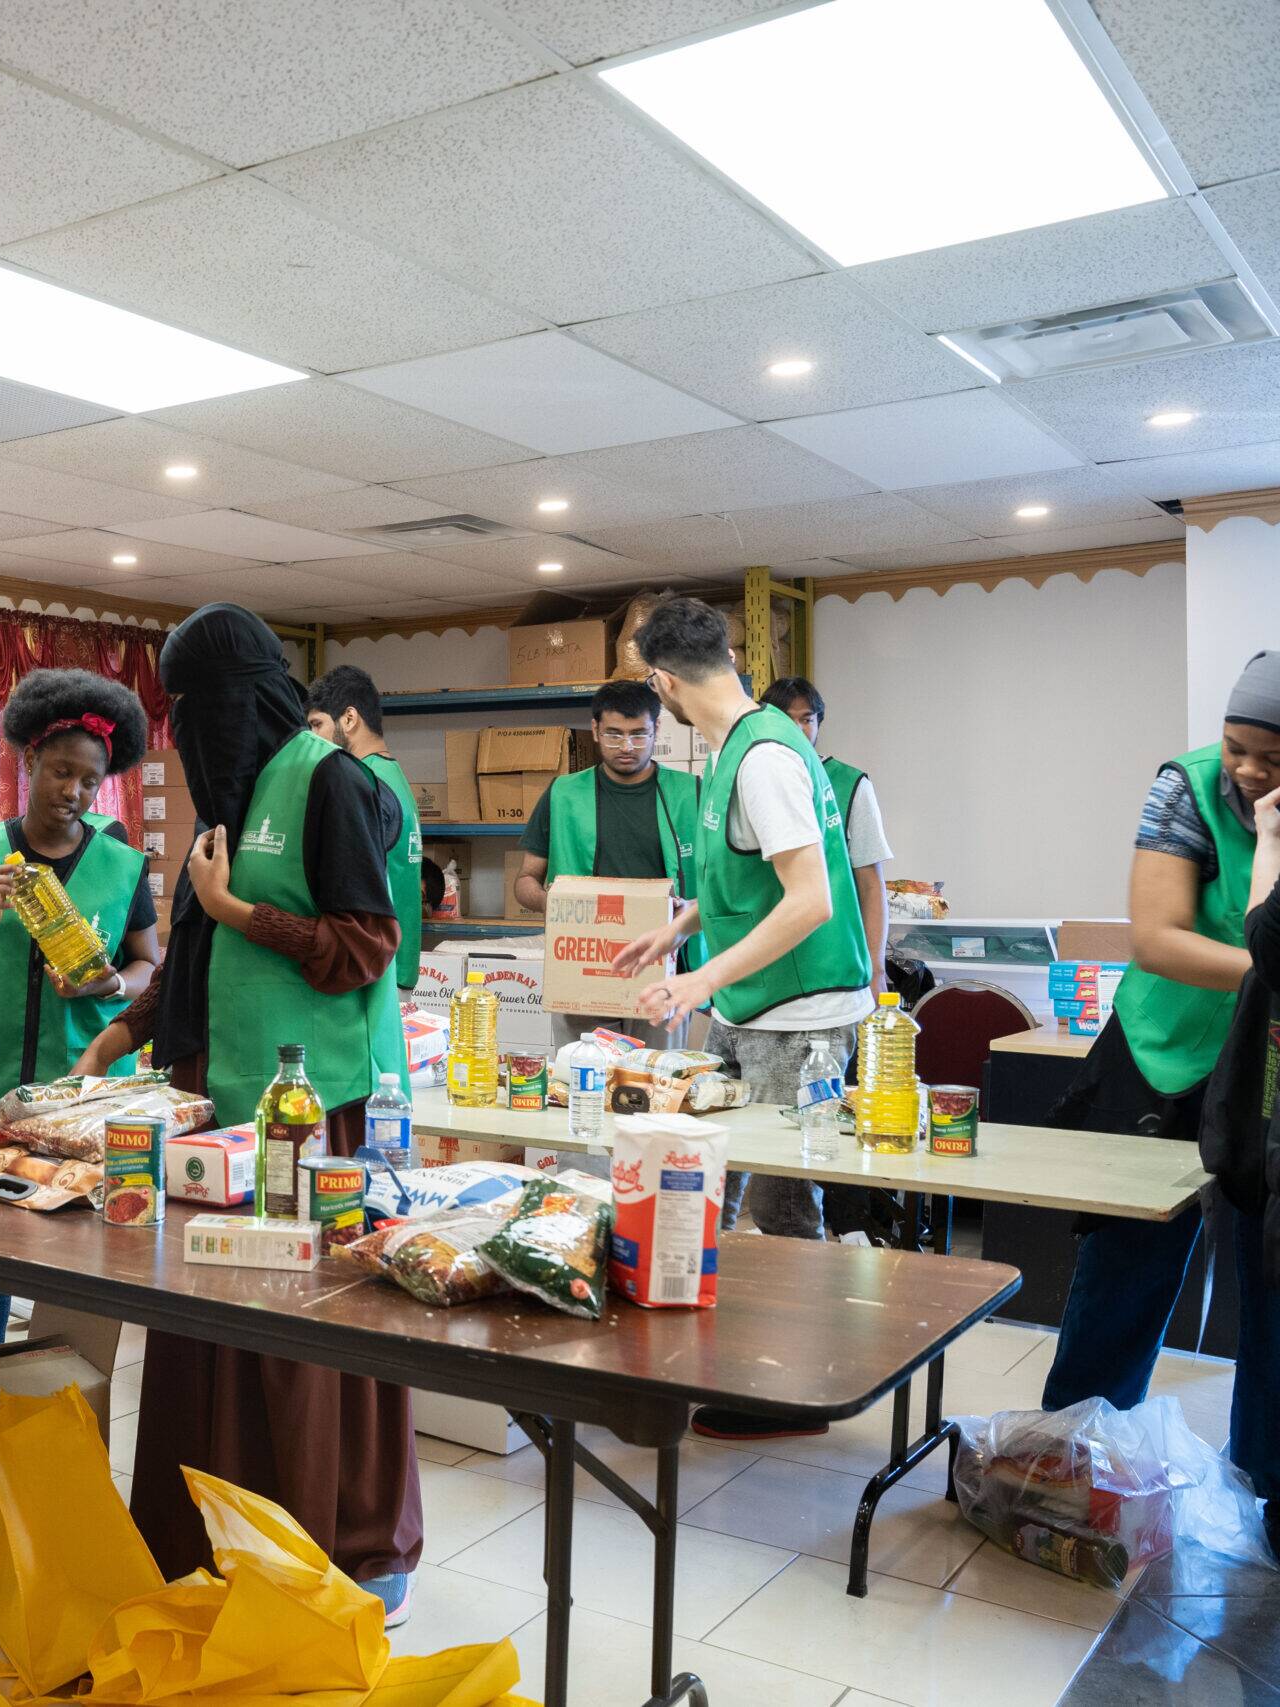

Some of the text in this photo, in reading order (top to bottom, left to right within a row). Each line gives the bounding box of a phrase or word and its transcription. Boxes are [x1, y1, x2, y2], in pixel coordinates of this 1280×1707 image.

[554, 937, 608, 962] GREEN
[429, 967, 449, 985] RAY
[484, 970, 538, 989] OLDEN RAY
[439, 987, 455, 999] Oil
[527, 993, 543, 1005] Oil
[512, 1096, 541, 1107] PRIMO
[107, 1130, 149, 1147] PRIMO
[935, 1139, 970, 1152] PRIMO
[319, 1173, 362, 1189] PRIMO
